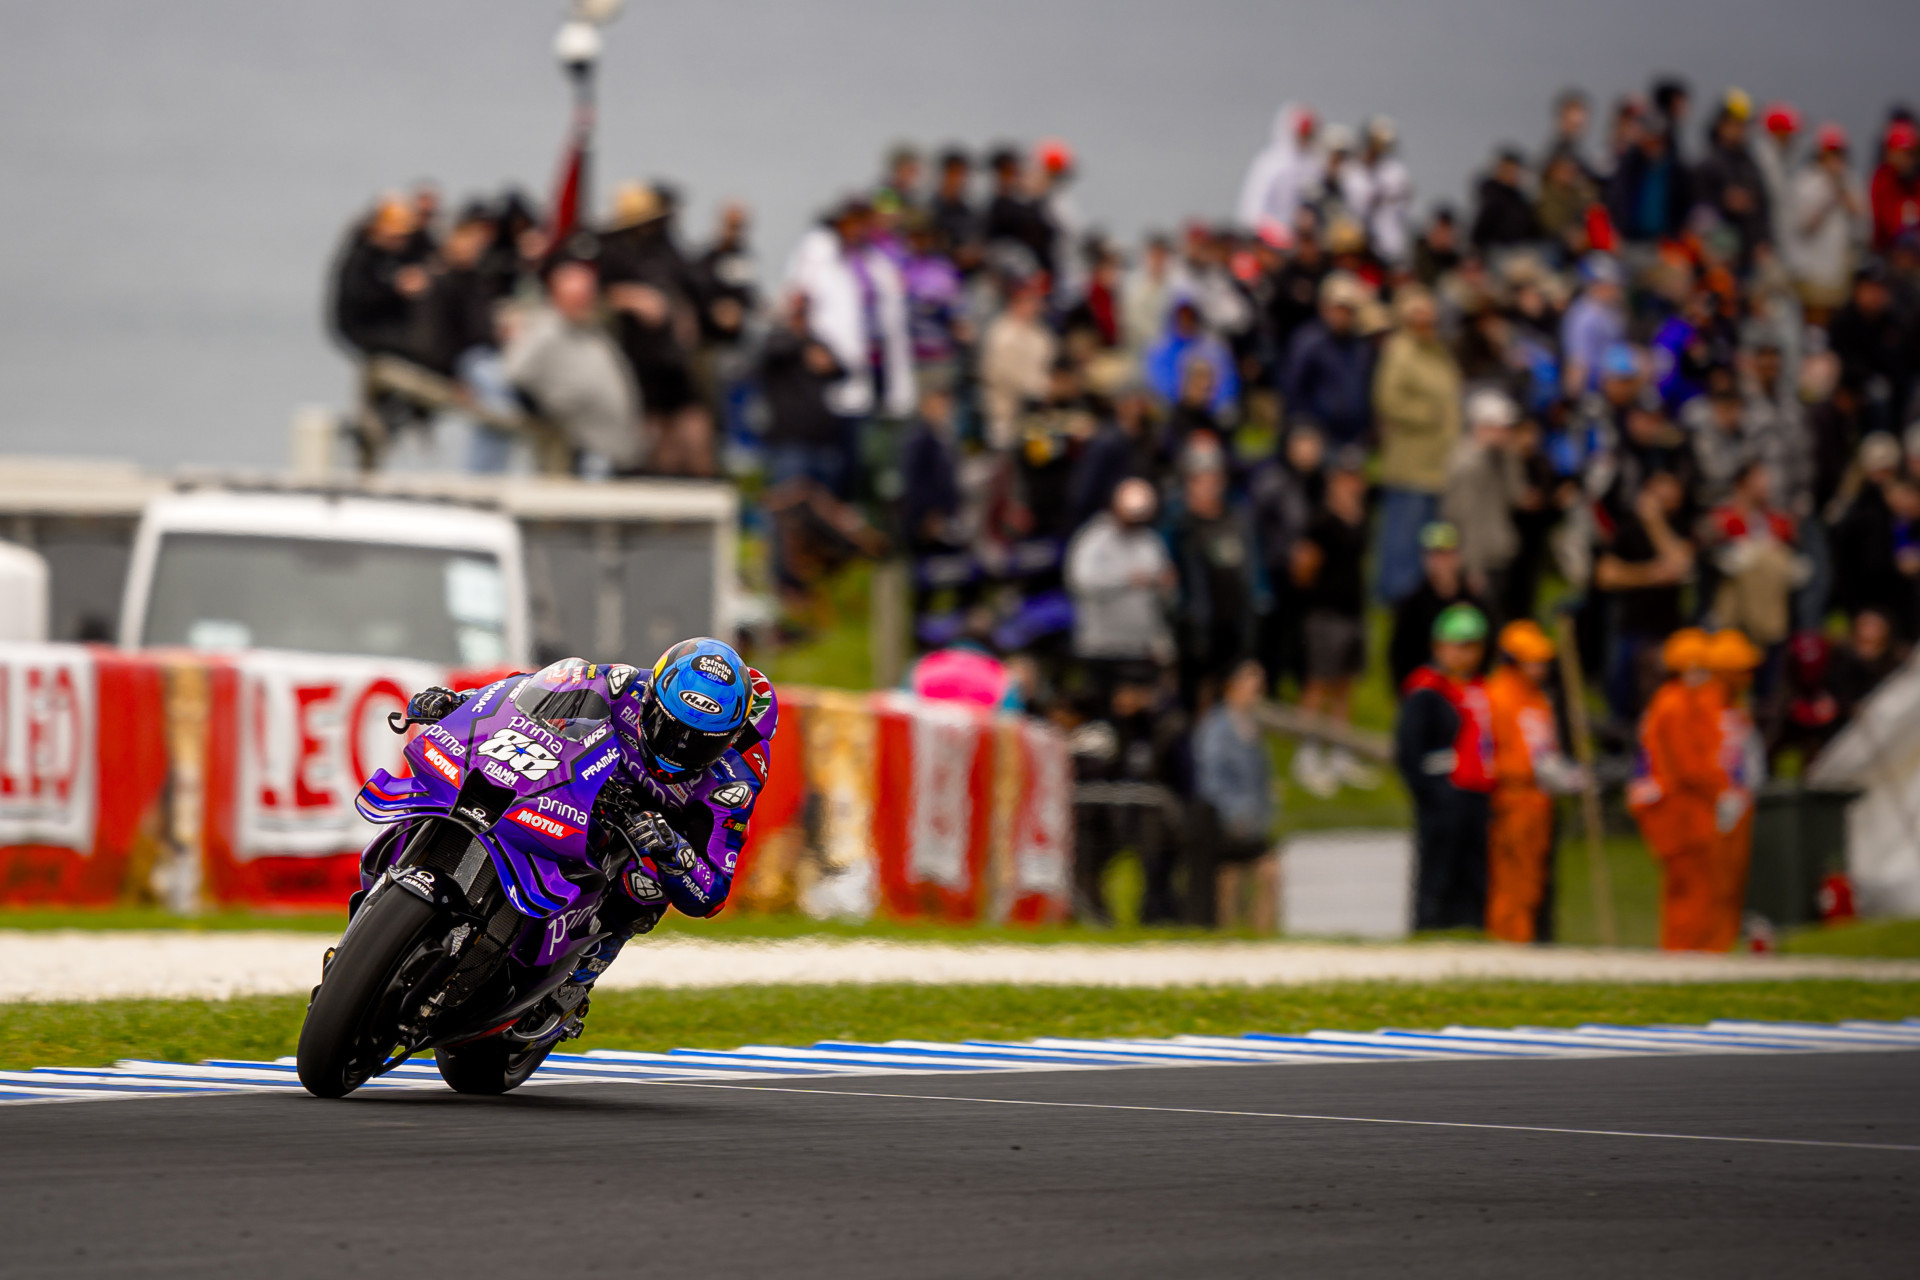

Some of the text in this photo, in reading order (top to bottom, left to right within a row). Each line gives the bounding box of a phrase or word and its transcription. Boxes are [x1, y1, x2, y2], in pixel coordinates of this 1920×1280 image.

[699, 664, 728, 681] Galicia
[700, 656, 732, 676] Estrella
[471, 680, 507, 713] PRAMAC
[684, 693, 718, 712] HJC
[424, 724, 466, 757] prima
[508, 715, 563, 754] prima
[584, 724, 608, 749] WRS
[425, 747, 458, 781] MOTUL
[484, 761, 520, 787] FIAMM
[516, 810, 564, 837] MOTUL
[537, 796, 588, 826] prima
[402, 877, 430, 896] YAMAHA
